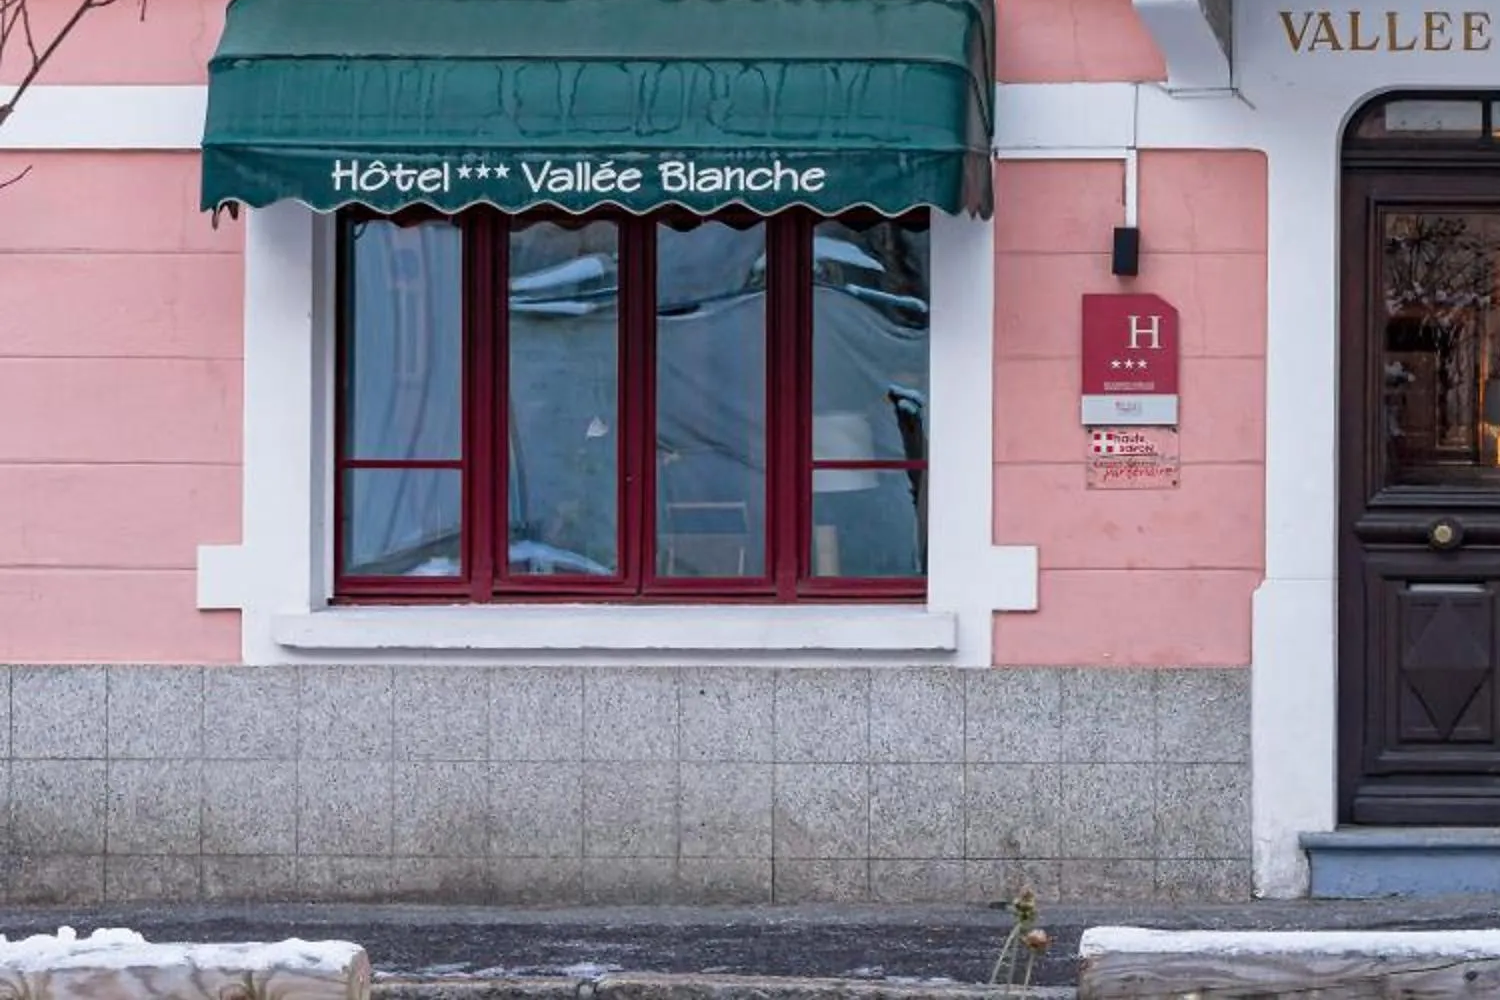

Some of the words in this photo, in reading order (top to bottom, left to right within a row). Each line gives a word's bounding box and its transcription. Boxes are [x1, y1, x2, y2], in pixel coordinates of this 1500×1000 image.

[1280, 10, 1492, 53] VALLEE
[331, 158, 450, 193] Hôtel
[521, 160, 642, 193] Vallée
[659, 160, 826, 192] Blanche
[1126, 314, 1163, 349] H
